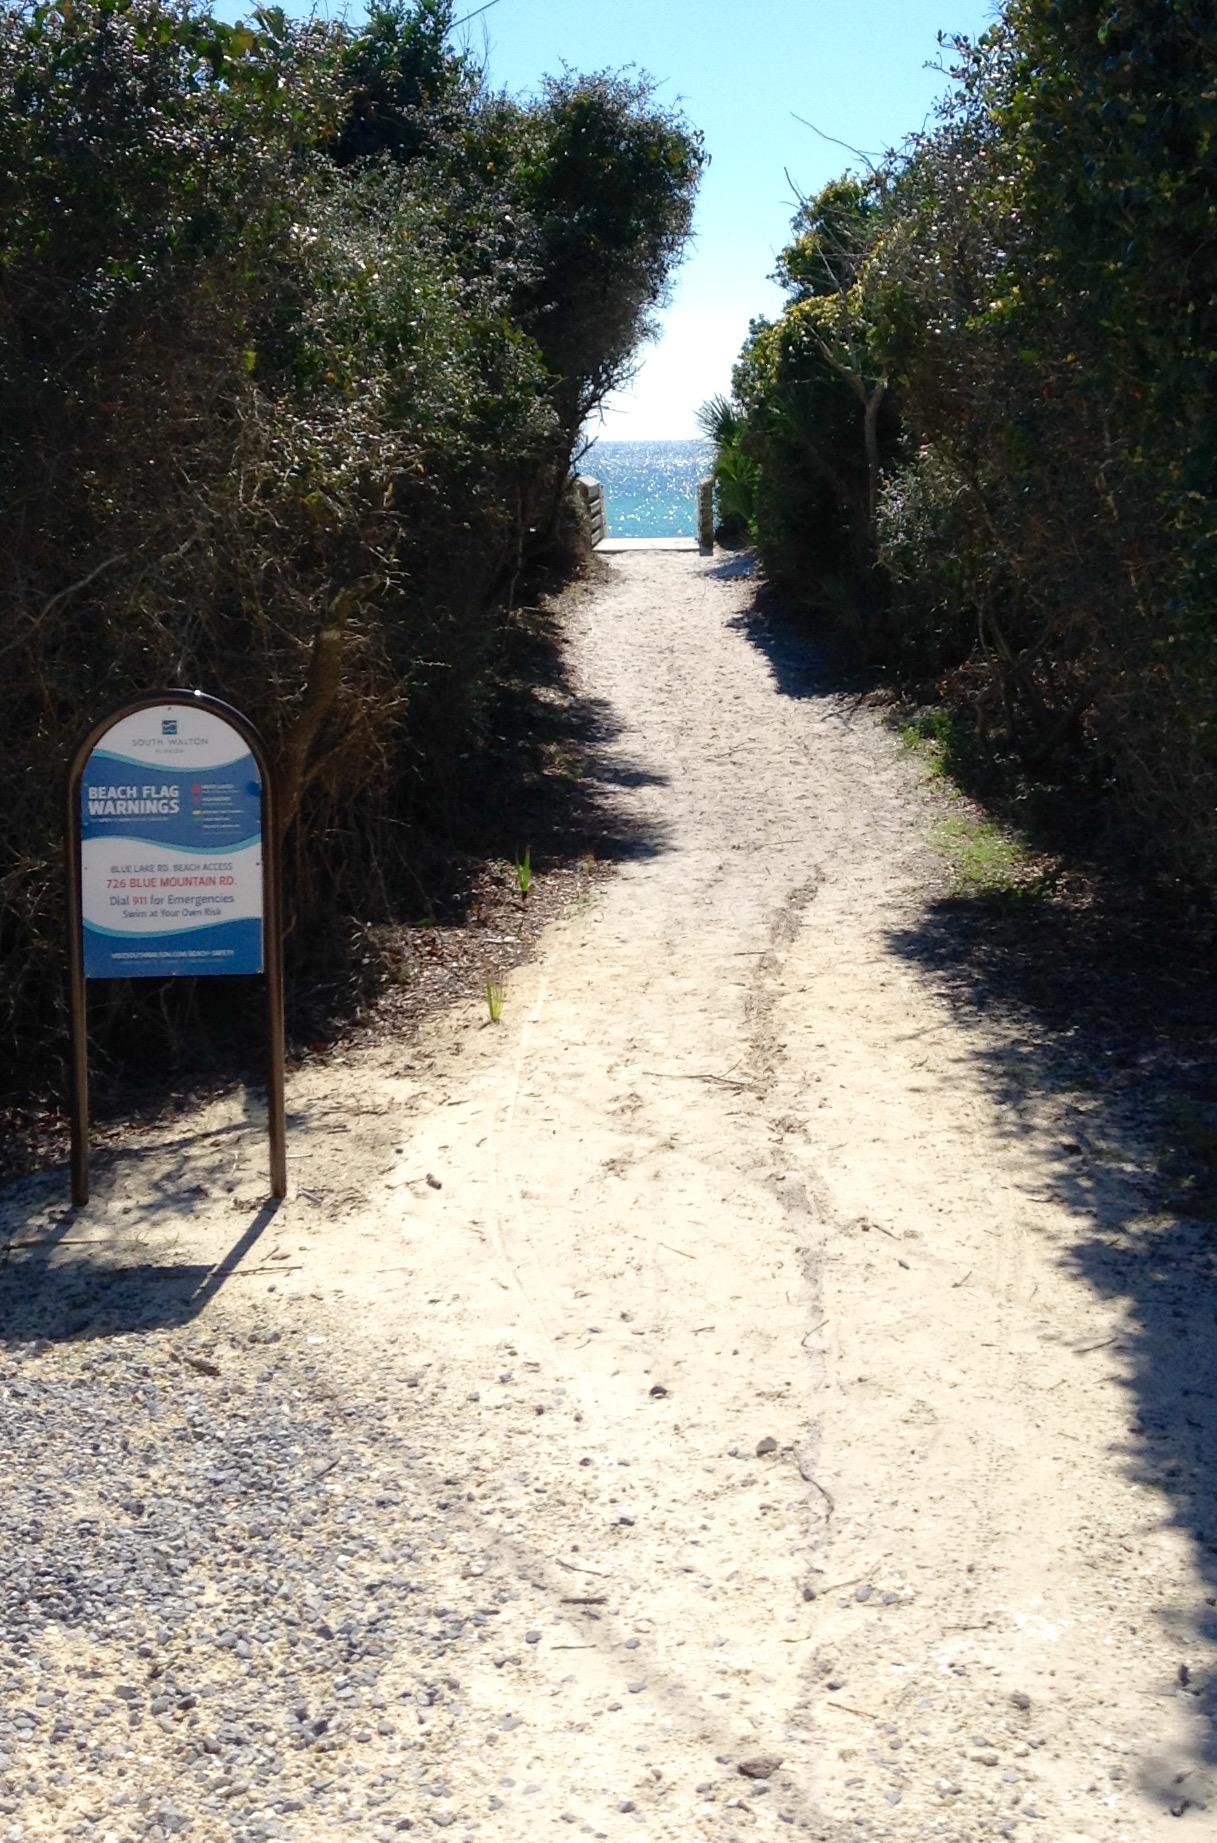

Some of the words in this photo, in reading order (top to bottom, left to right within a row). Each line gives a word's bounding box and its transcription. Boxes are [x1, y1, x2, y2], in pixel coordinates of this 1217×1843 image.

[132, 738, 164, 747] SOUTH
[168, 737, 209, 746] WALTON
[88, 786, 137, 799] BEACH
[142, 785, 180, 798] FLAG
[88, 800, 180, 815] WARNINGS
[110, 864, 131, 873] BLUE
[133, 864, 154, 873] LAKE
[173, 863, 200, 872] BEACH
[202, 862, 232, 871] ACCESS
[106, 879, 127, 889] 726
[129, 878, 157, 888] BLUE
[159, 876, 216, 887] MOUNTAIN
[219, 875, 237, 886] RD.
[109, 896, 130, 906] Dial
[132, 896, 147, 905] 911
[150, 895, 164, 905] for
[167, 894, 235, 906] Emergencies
[122, 910, 147, 918] Swim
[149, 910, 158, 918] at
[161, 908, 179, 918] Your
[182, 908, 202, 917] Own
[204, 907, 222, 916] Risk
